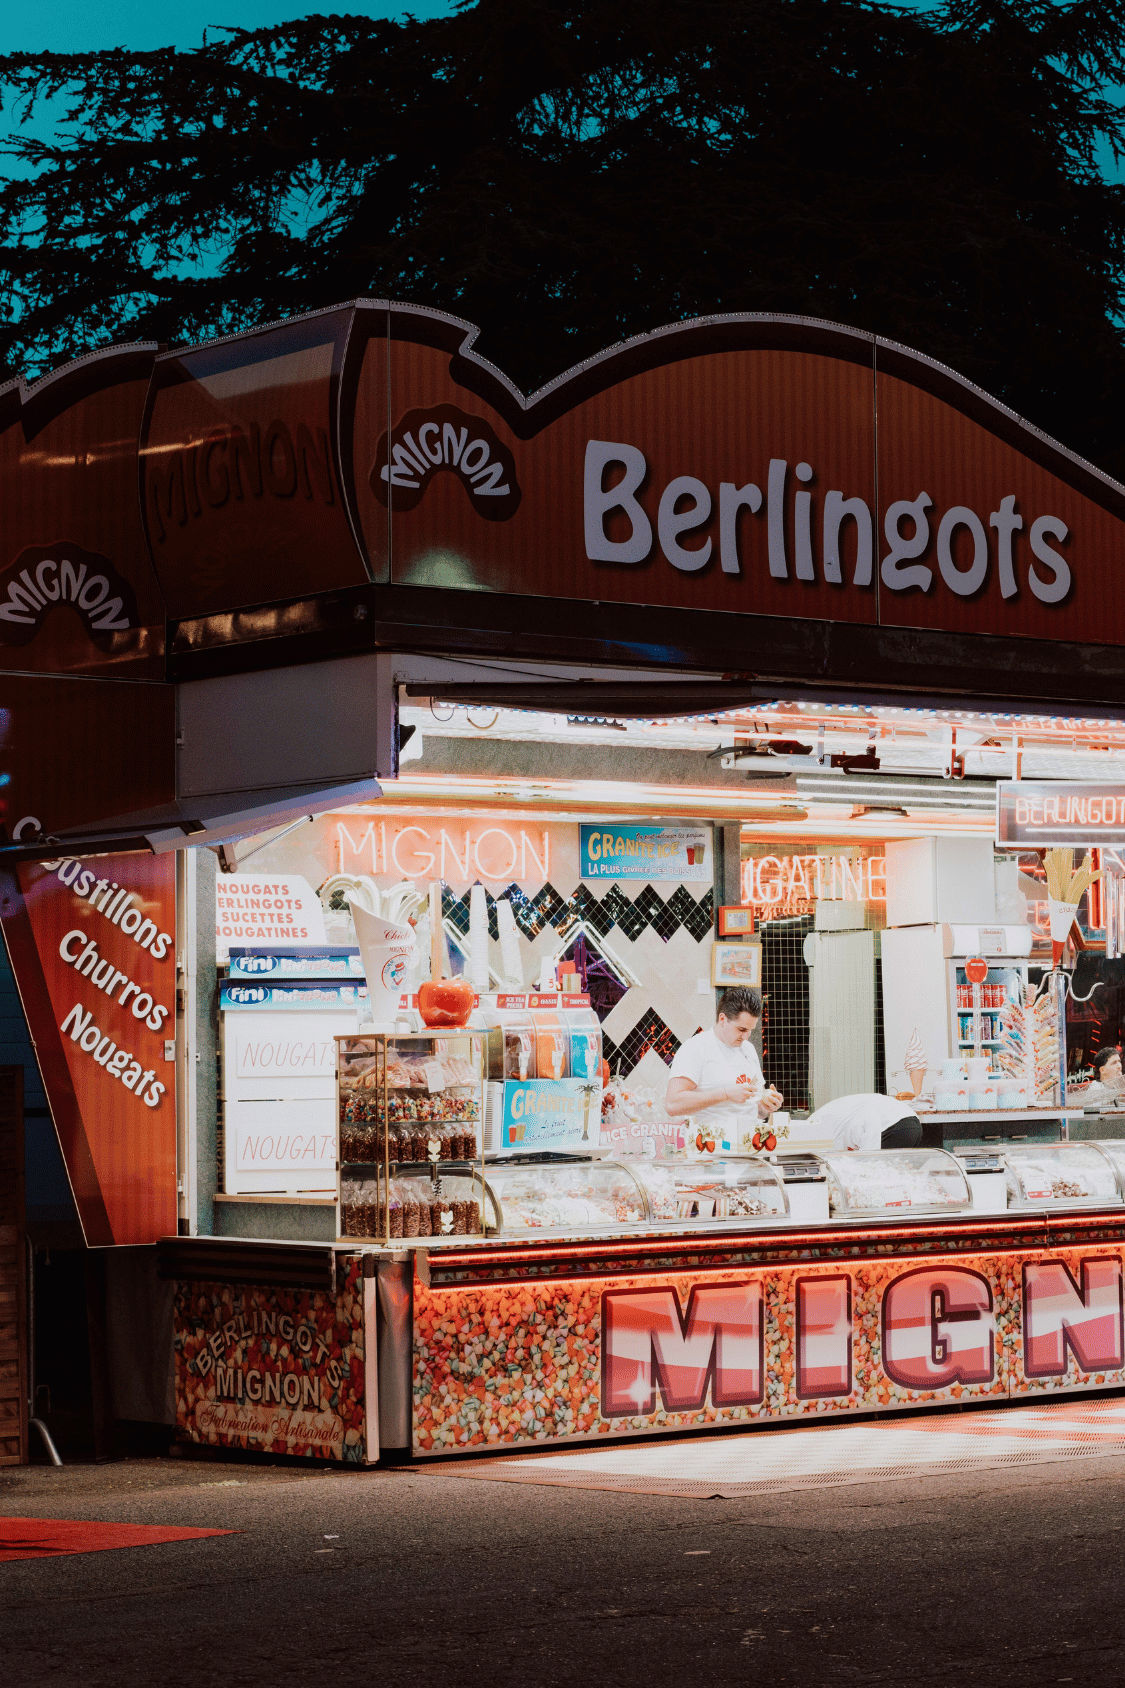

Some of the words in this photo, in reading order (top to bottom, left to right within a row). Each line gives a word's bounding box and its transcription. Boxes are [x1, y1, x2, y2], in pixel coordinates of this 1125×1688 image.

[381, 422, 510, 496] MIGNON
[149, 418, 336, 545] MIGNON
[583, 439, 1071, 603] Berlingots
[0, 560, 129, 631] MIGNON
[337, 821, 549, 880] MIGNON
[588, 832, 654, 860] GRANITE
[658, 841, 680, 858] ICE
[217, 883, 289, 895] NOUGATS
[588, 862, 599, 875] LA
[600, 863, 620, 874] PLUS
[217, 898, 302, 910] ERLINGOTS
[222, 912, 294, 923] SUCETTES
[59, 930, 168, 1031] Churros
[240, 957, 272, 971] Fini
[231, 987, 264, 1002] Fini
[60, 1003, 166, 1107] Nougats
[511, 1089, 575, 1119] GRANITE
[195, 1310, 343, 1388] BERLINGOTS
[216, 1365, 320, 1407] MIGNON
[199, 1403, 270, 1434] Fabrication
[270, 1416, 339, 1443] Artisanale
